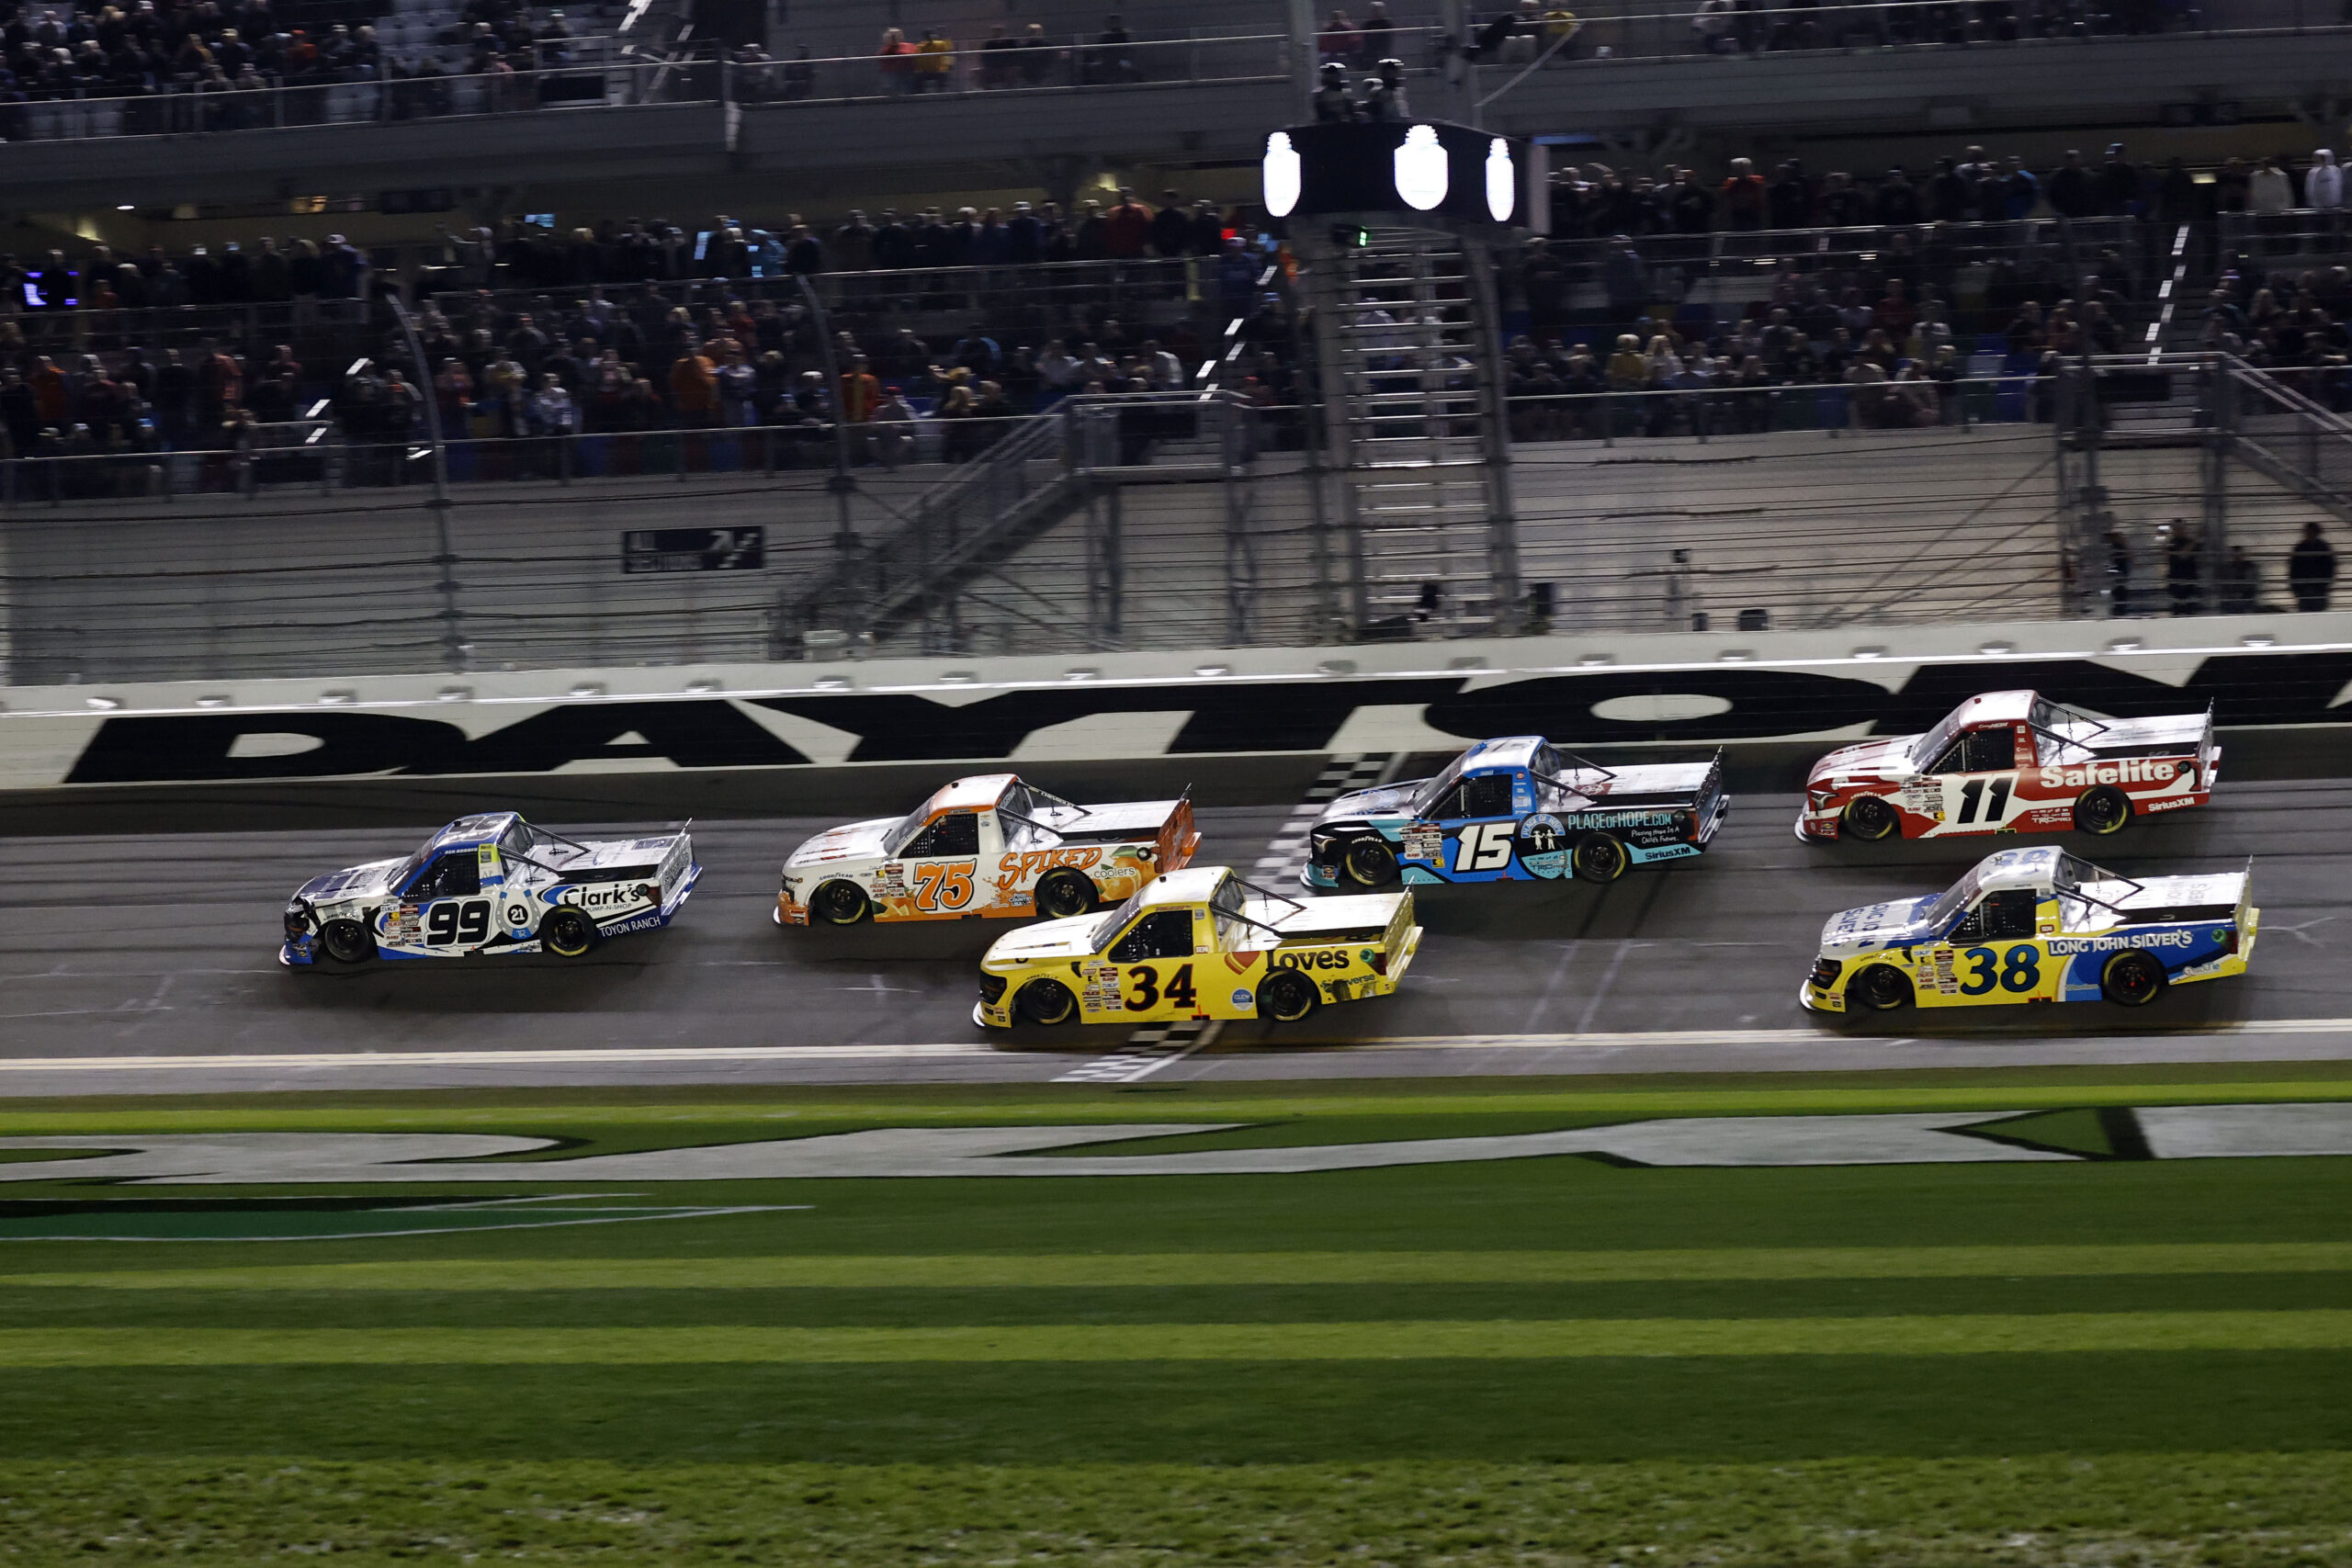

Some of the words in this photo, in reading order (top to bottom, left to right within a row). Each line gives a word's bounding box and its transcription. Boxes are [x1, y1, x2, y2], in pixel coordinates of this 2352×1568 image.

[64, 653, 2352, 783] DAYTON
[2040, 759, 2175, 788] Safelite
[1957, 779, 2012, 824] 11
[2148, 797, 2195, 812] SiriusXM
[1351, 835, 1383, 844] GOODYEAR
[1452, 821, 1519, 872] 15
[1645, 846, 1691, 861] SiriusXM
[998, 847, 1102, 890] SPIKED
[1093, 866, 1136, 880] coolers
[564, 884, 641, 907] Clark's
[913, 858, 978, 911] 75
[425, 899, 492, 946] 99
[510, 908, 526, 921] 21
[599, 922, 630, 937] TOYON
[631, 916, 662, 931] RANCH
[2049, 941, 2089, 954] LONG
[2092, 937, 2130, 953] JOHN
[2130, 929, 2193, 949] SILVER'S
[1266, 949, 1351, 972] Loves
[1960, 944, 2040, 996] 38
[1124, 964, 1196, 1010] 34
